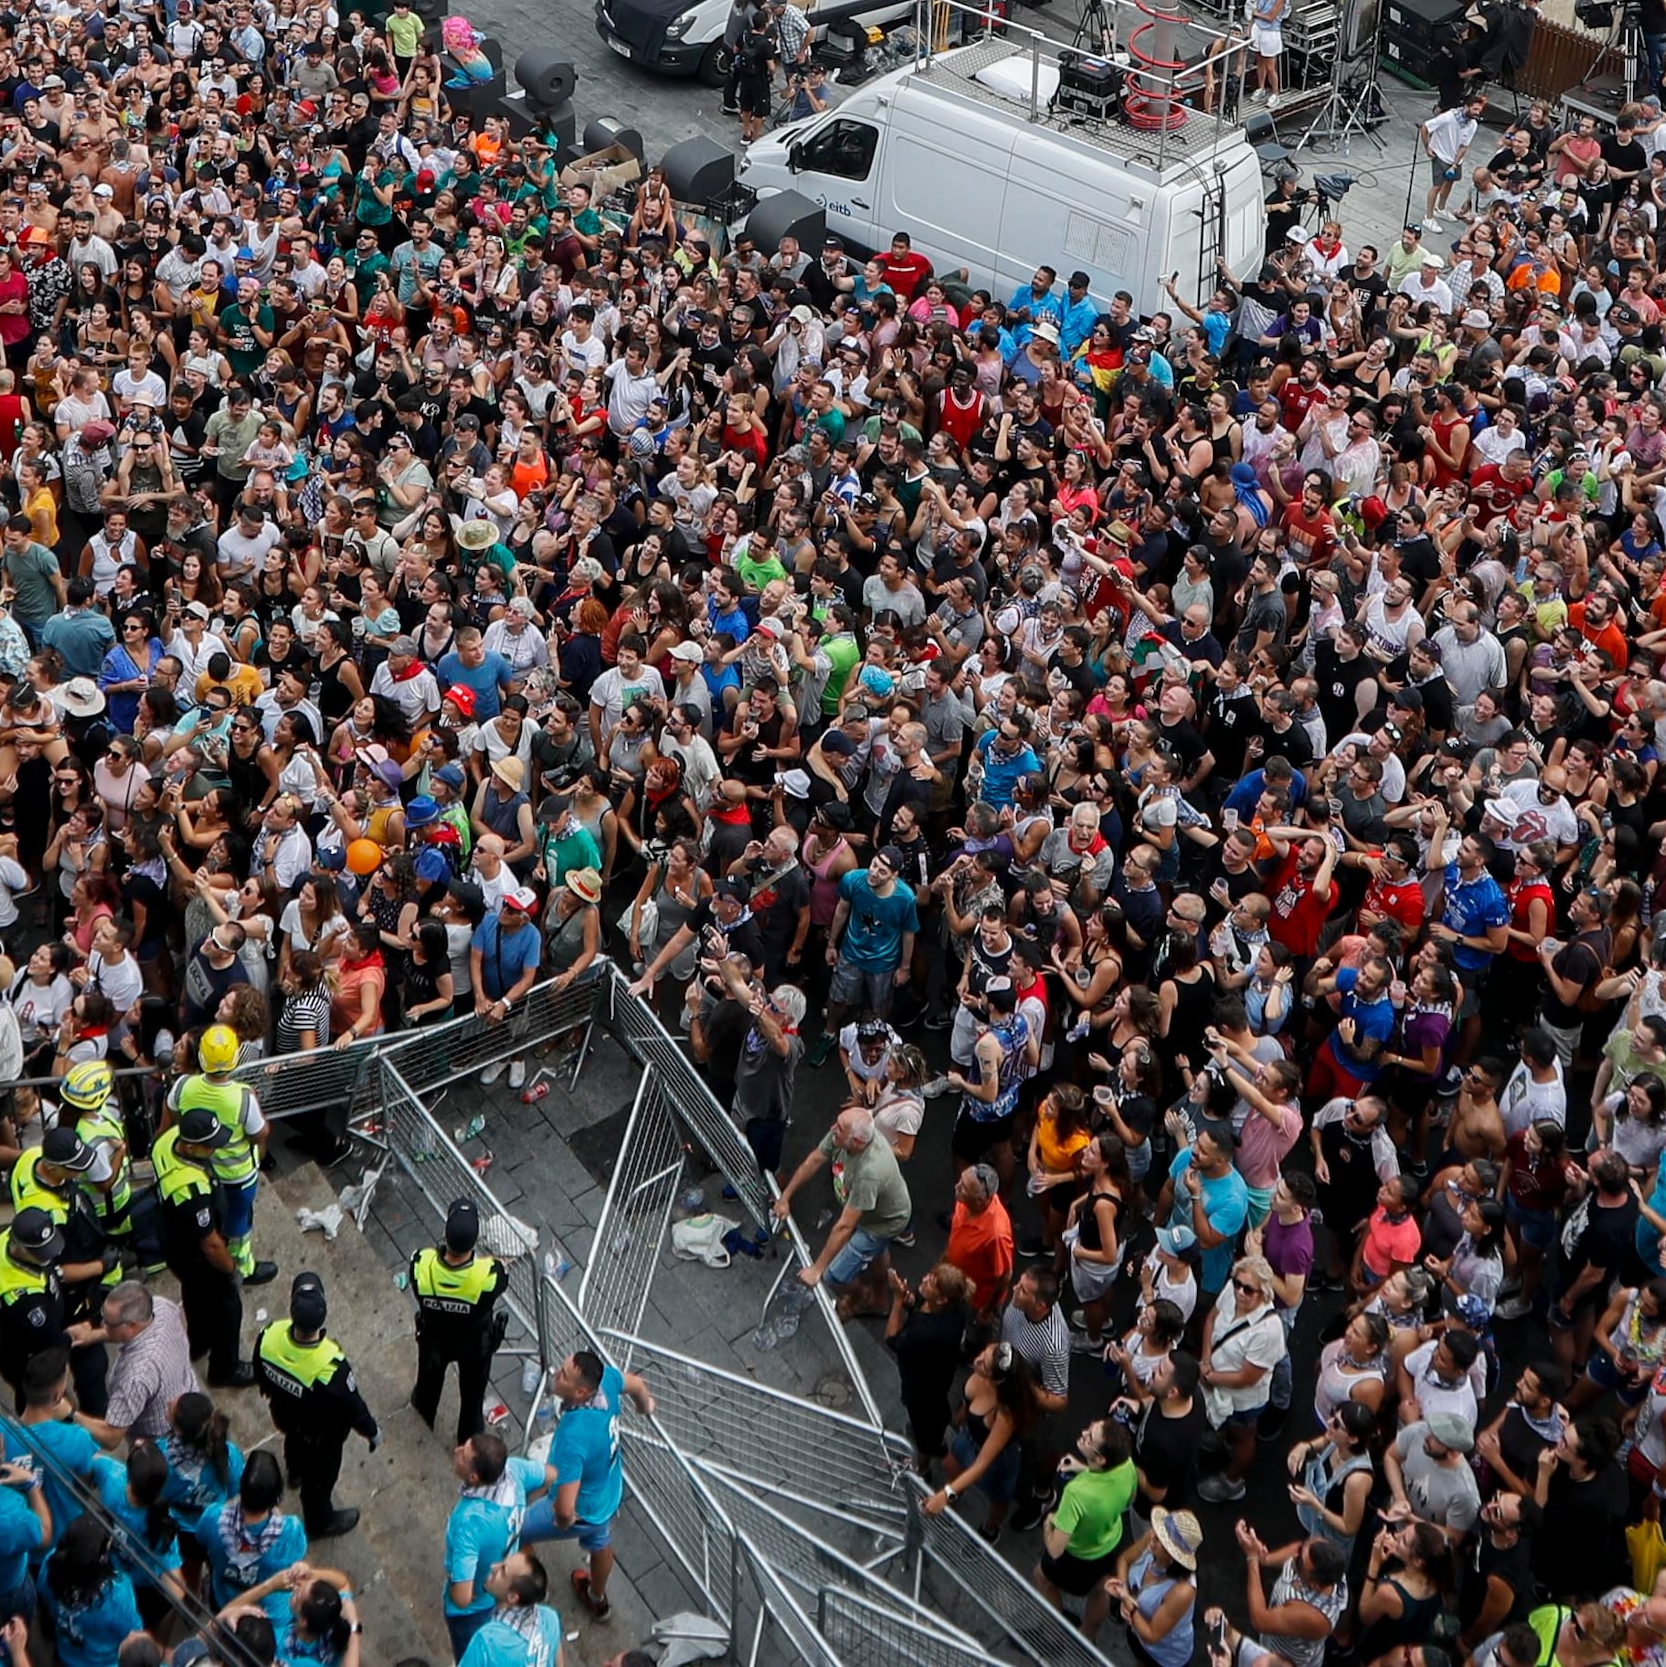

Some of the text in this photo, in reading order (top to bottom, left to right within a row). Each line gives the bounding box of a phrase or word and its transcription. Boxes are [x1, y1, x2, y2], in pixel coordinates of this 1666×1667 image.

[829, 201, 851, 216] eitb
[426, 1299, 469, 1313] POLIZIA
[263, 1365, 303, 1397] POLIZIA
